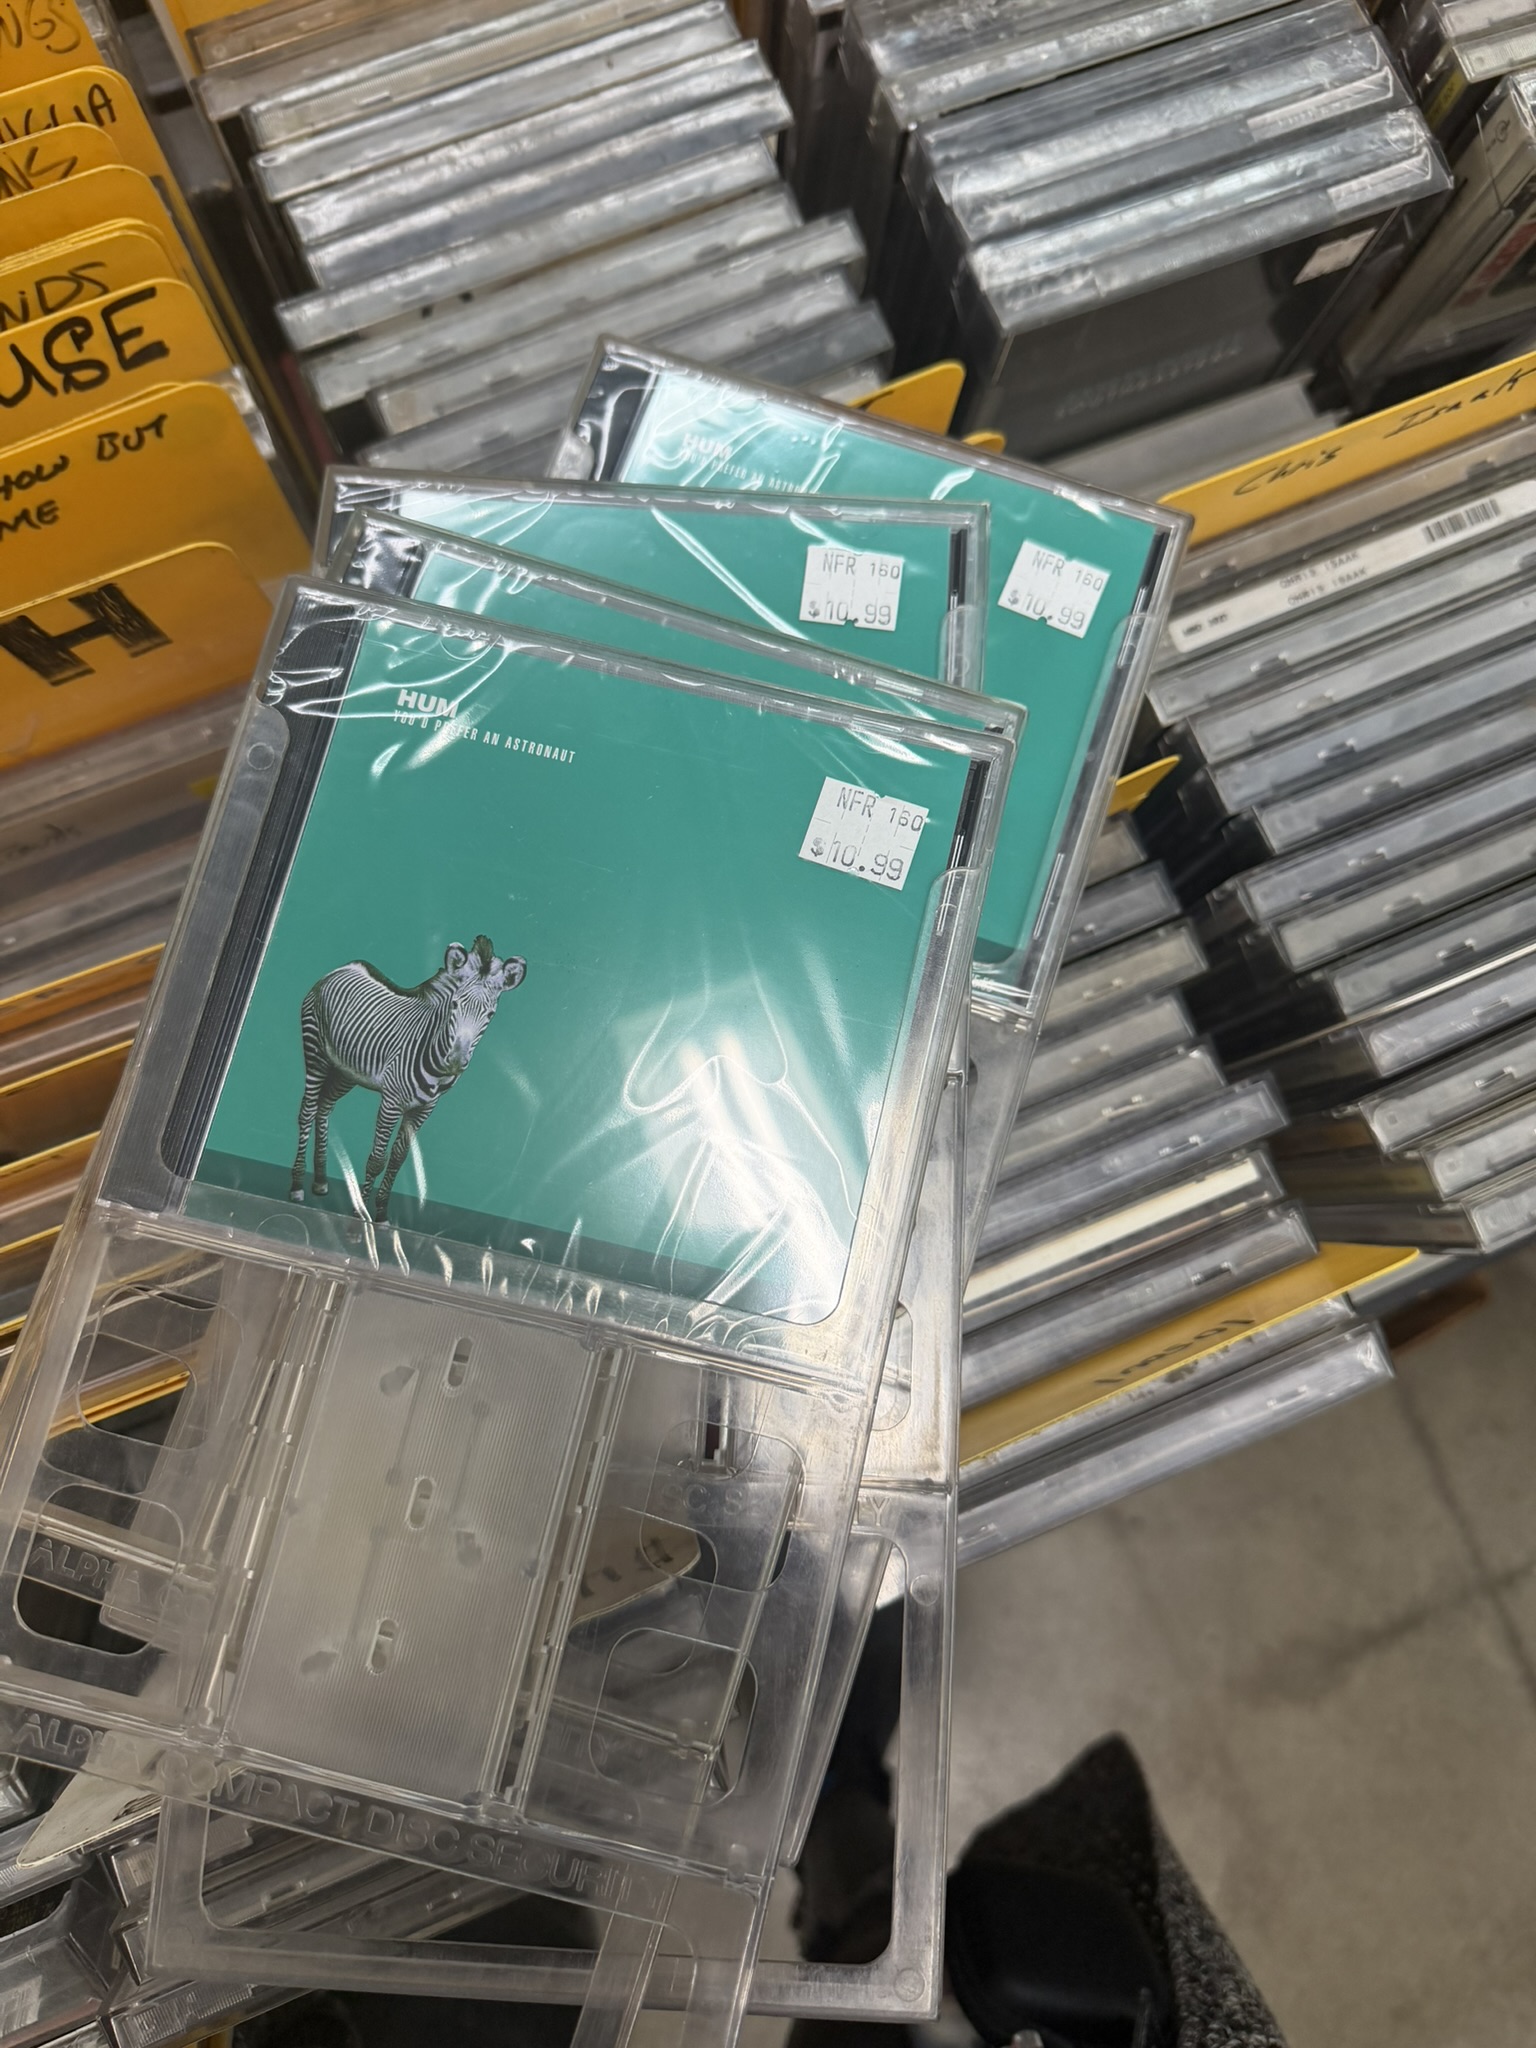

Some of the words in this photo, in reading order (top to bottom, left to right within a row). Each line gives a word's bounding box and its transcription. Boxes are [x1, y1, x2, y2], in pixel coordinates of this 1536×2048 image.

[97, 413, 168, 462] BUT
[822, 553, 856, 576] NFR
[869, 561, 901, 580] 160
[1031, 550, 1065, 578] NFR
[1074, 568, 1104, 593] 160
[0, 582, 173, 686] H
[397, 688, 460, 718] HUM
[483, 731, 501, 747] AN
[504, 735, 576, 764] ASTRONAUT
[836, 786, 877, 818] NFR
[889, 807, 924, 832] 160
[810, 836, 904, 881] $10.99
